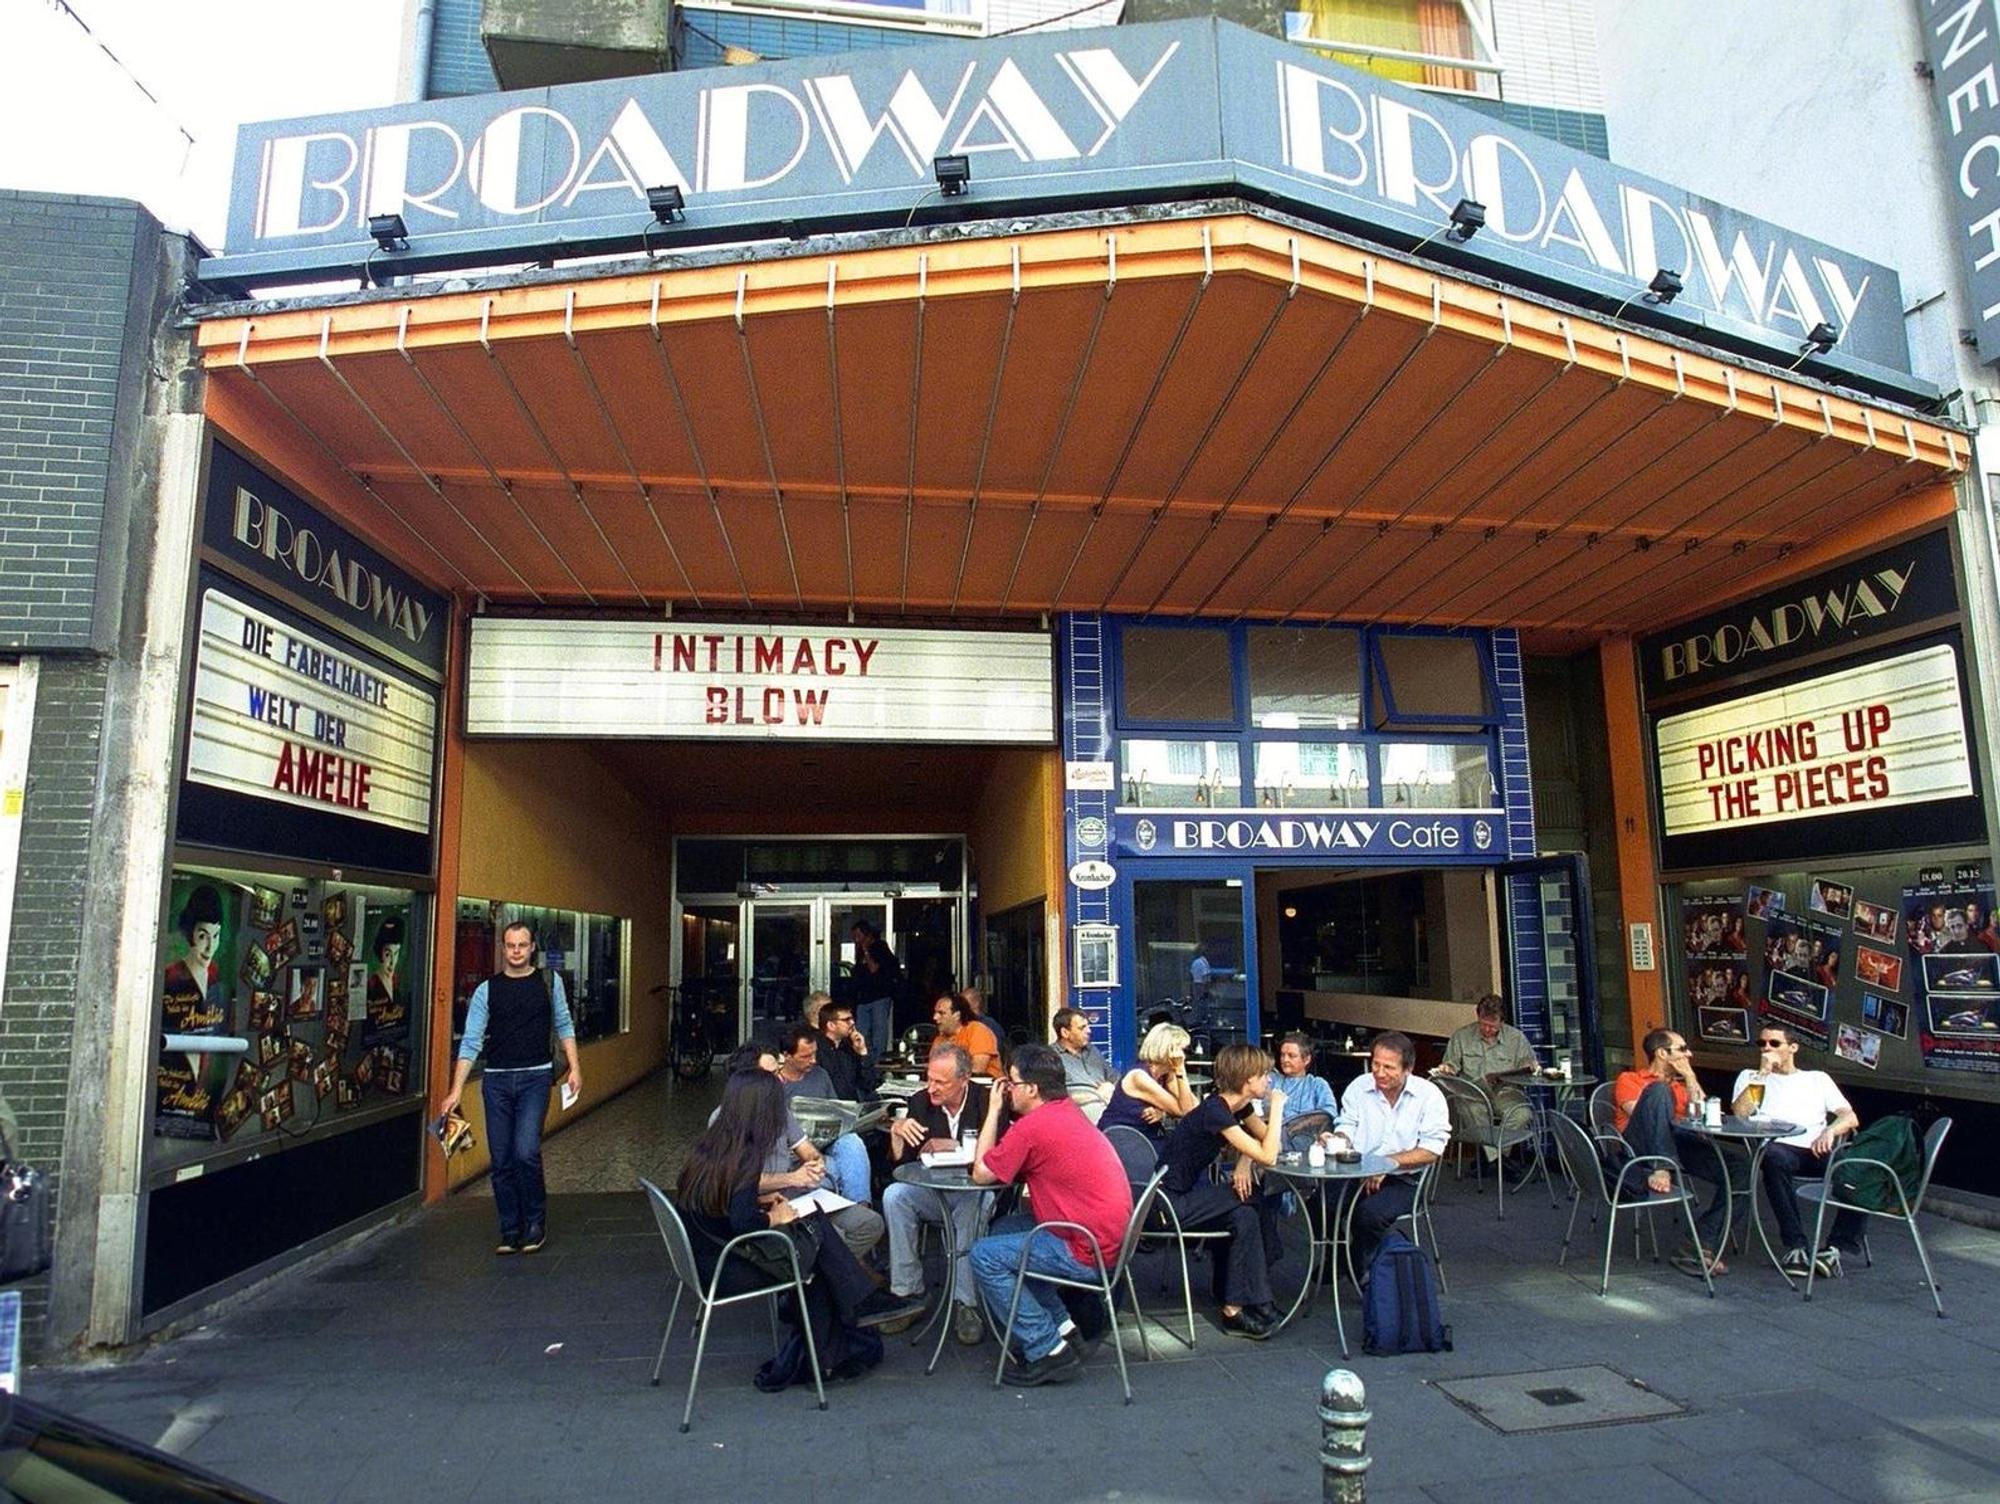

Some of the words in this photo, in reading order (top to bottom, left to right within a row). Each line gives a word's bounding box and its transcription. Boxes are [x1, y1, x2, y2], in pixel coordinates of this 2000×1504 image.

[253, 41, 1181, 240] BROADWAY
[1276, 60, 1870, 344] BROADWAY
[233, 486, 433, 644] BROADWAY
[654, 634, 878, 676] INTIMACY
[1662, 561, 1916, 681] BROADWAY
[242, 617, 273, 659] DIE
[285, 637, 389, 709] FABELHAFTE
[248, 684, 298, 731] WELT
[315, 713, 346, 747] DER
[706, 686, 829, 725] BLOW
[274, 741, 372, 811] AMELIE
[1698, 720, 1818, 781] PICKING
[1842, 704, 1892, 753] UP
[1708, 779, 1761, 821] THE
[1773, 756, 1890, 813] PIECES
[1173, 821, 1380, 848] BROADWAY
[1388, 821, 1459, 847] Cafe
